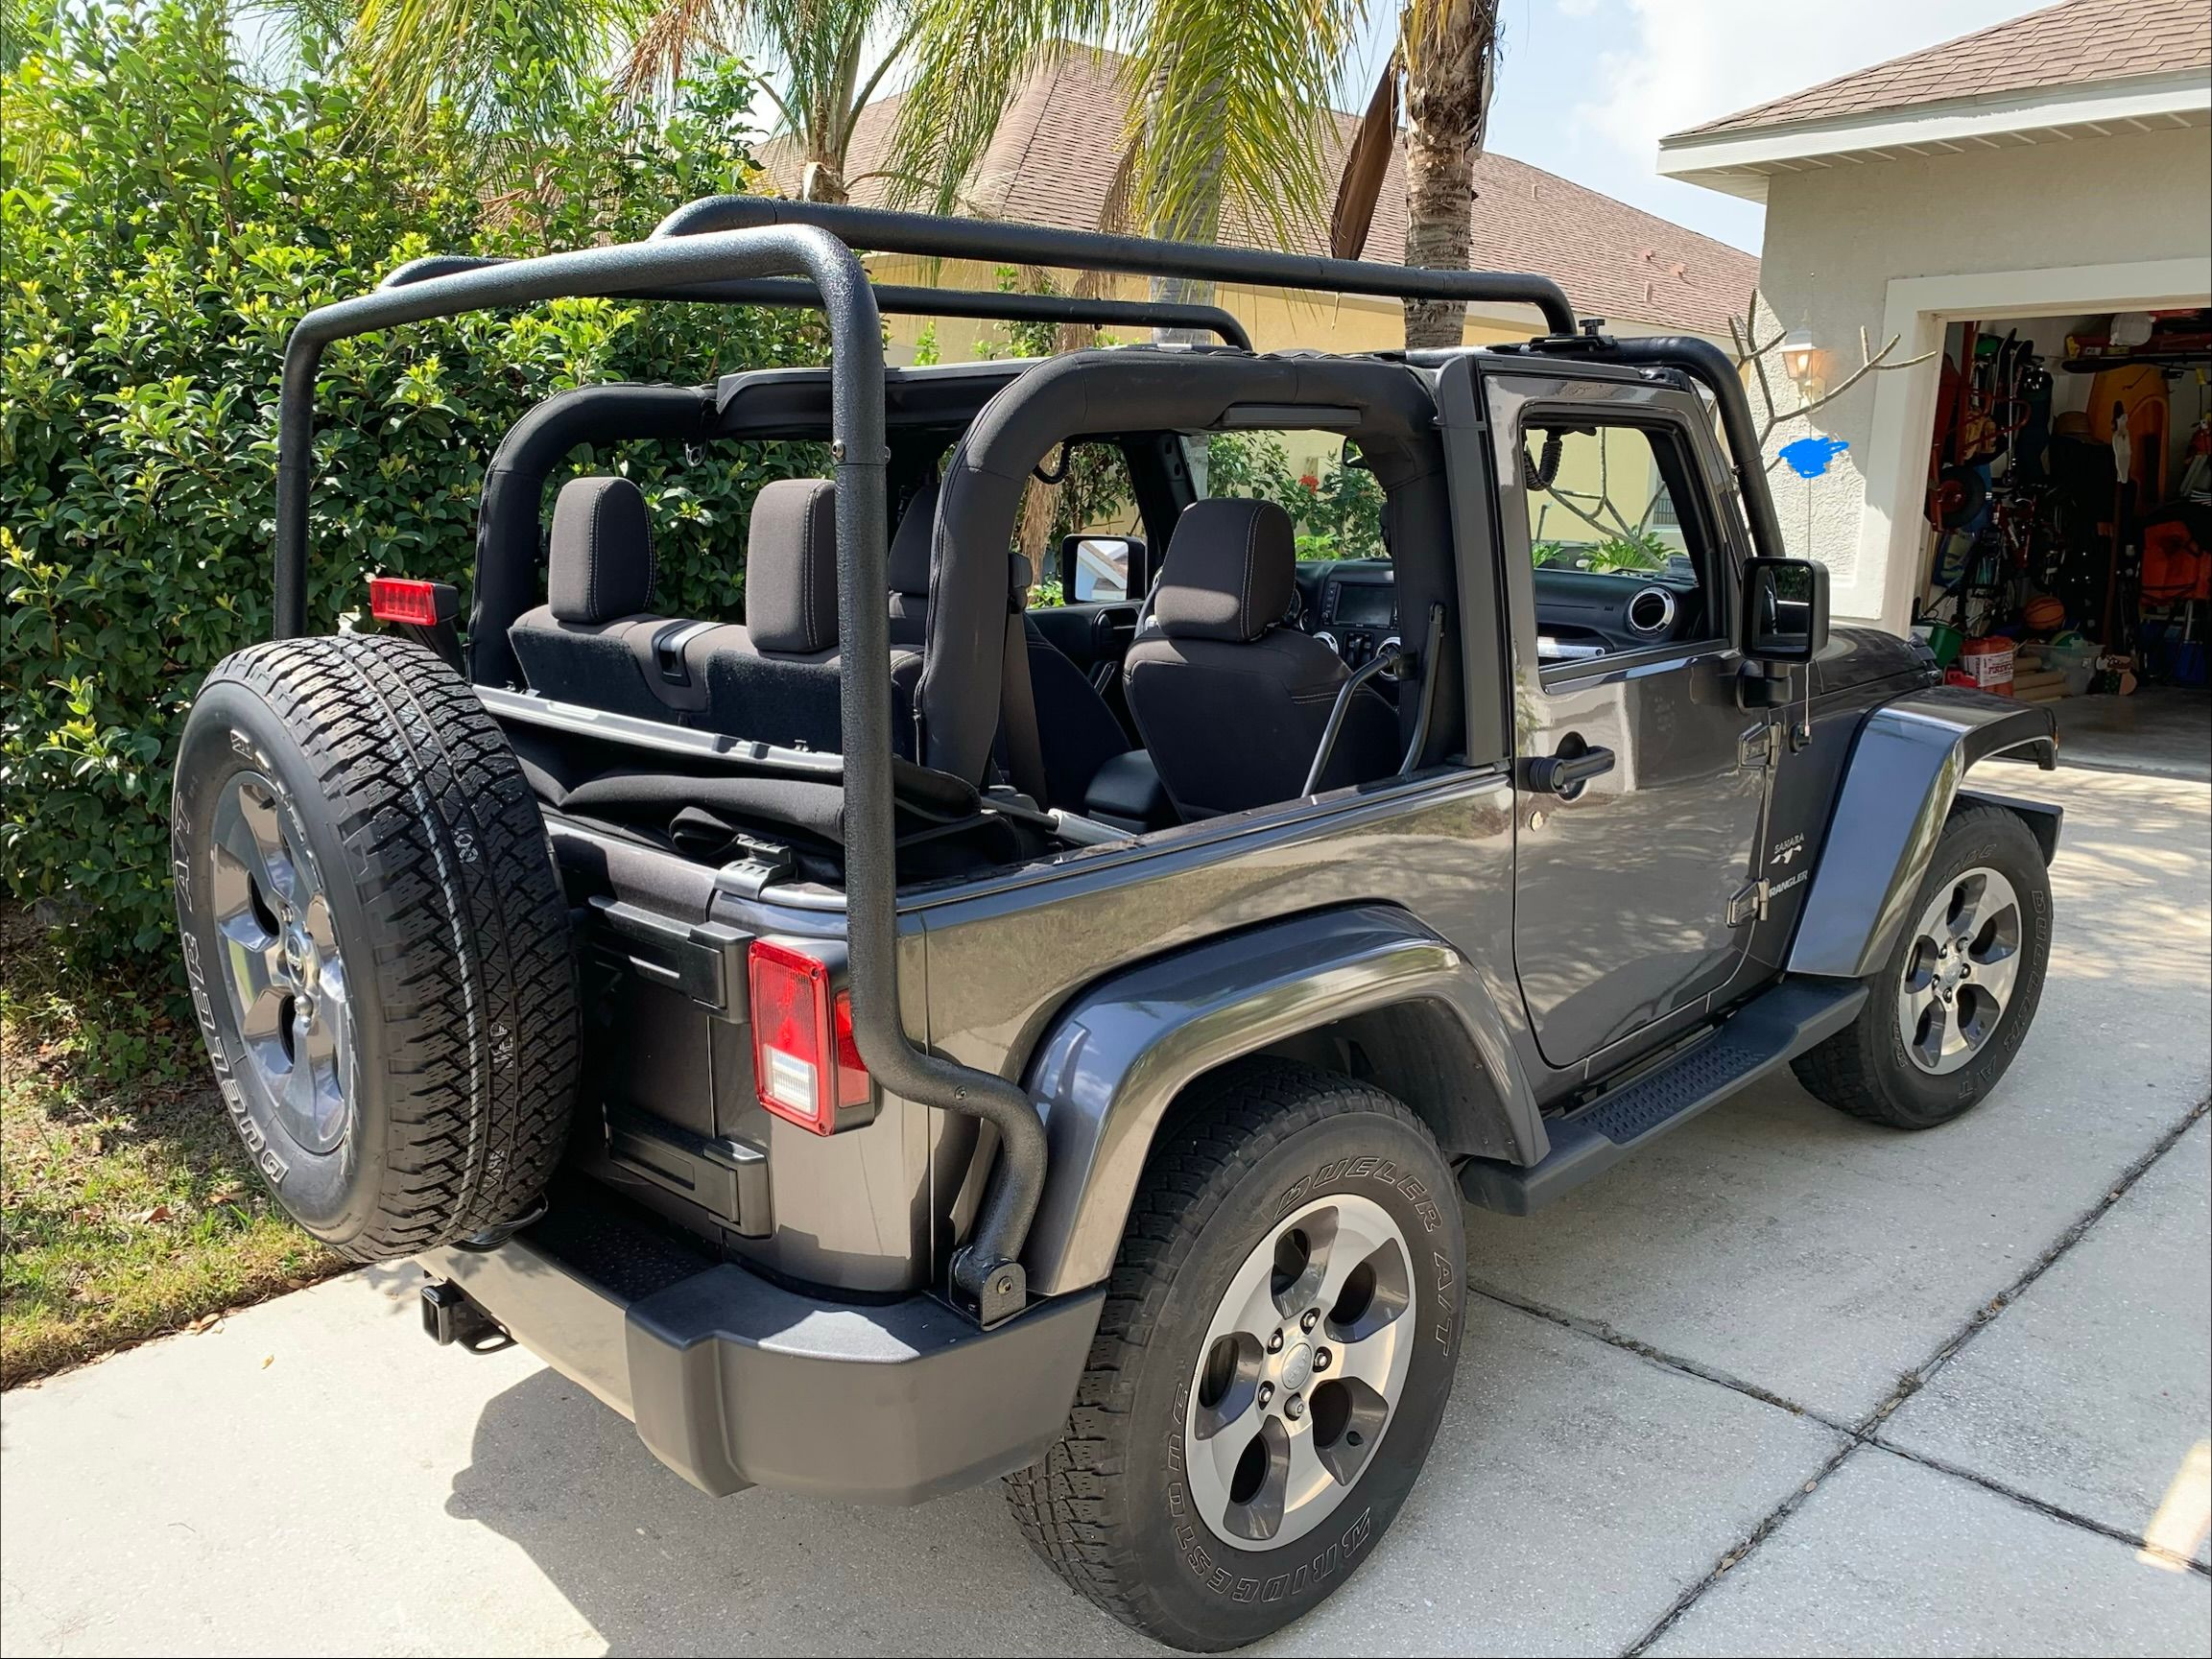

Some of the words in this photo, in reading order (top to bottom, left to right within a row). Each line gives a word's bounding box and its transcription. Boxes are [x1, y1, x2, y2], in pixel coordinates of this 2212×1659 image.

[175, 791, 193, 913] A/T
[1768, 869, 1808, 898] RANGLER
[1774, 832, 1805, 855] SAHARA
[182, 931, 289, 1184] DUELER
[1273, 1156, 1443, 1233] DUELER
[1433, 1251, 1454, 1358] A/T
[1168, 1382, 1371, 1603] BRIDGESTONE
